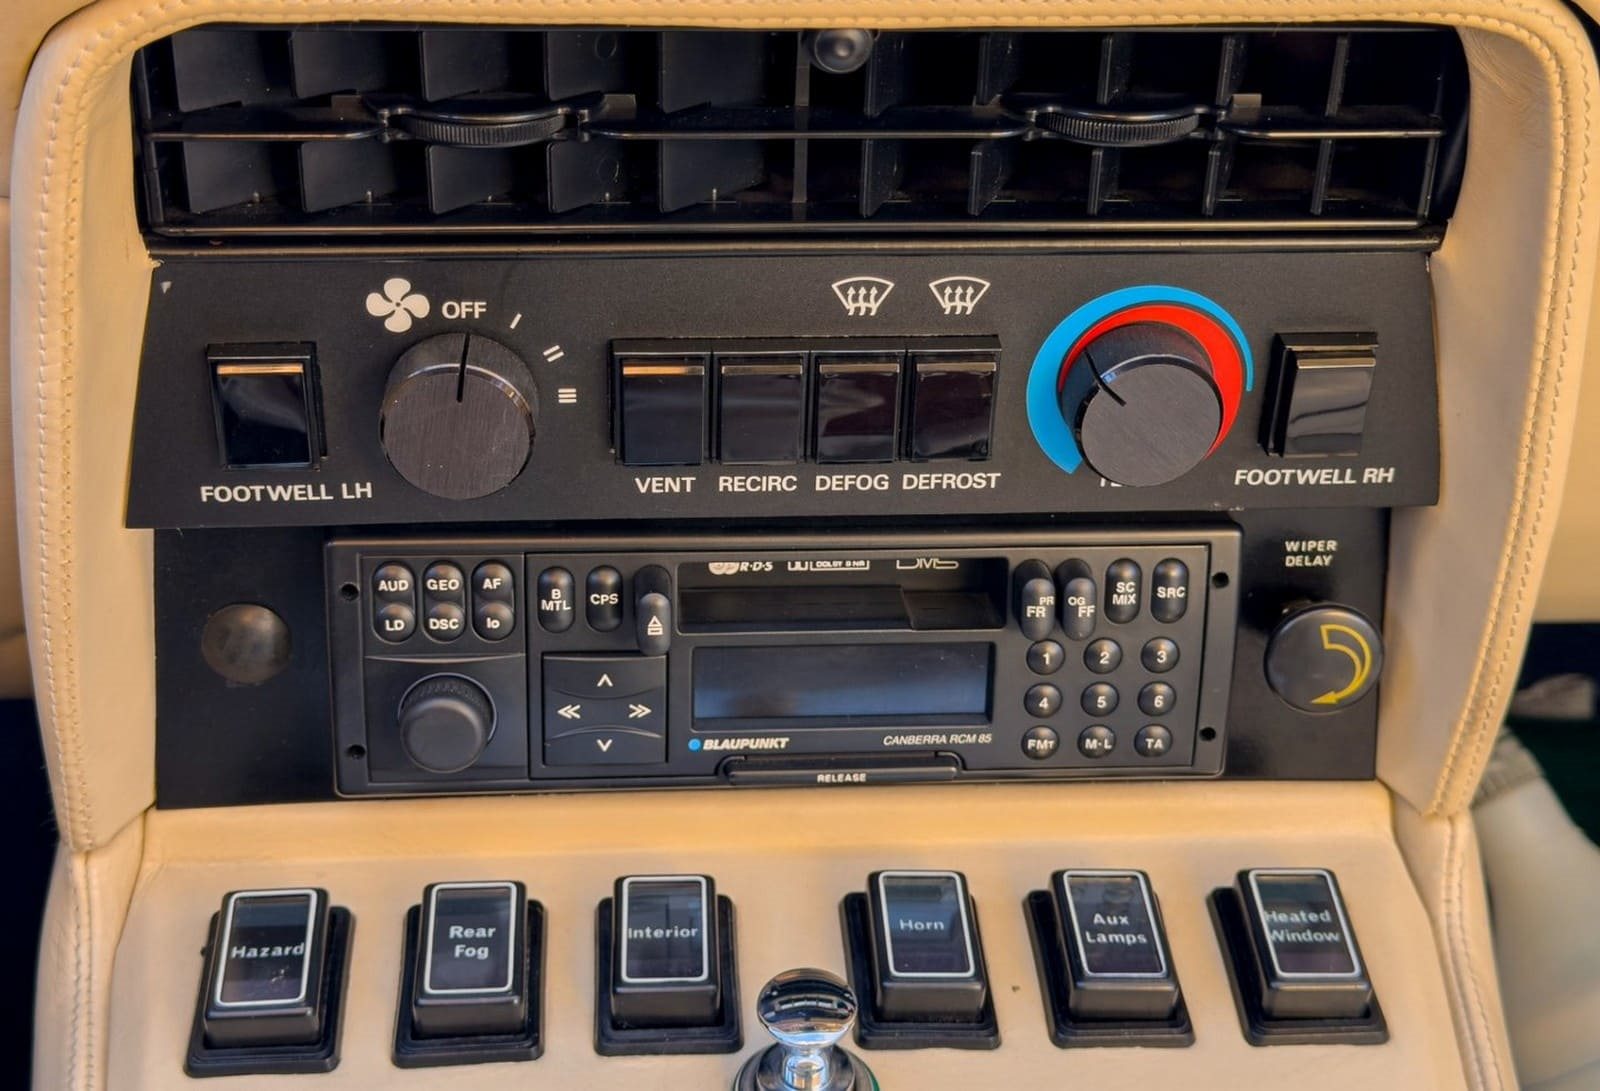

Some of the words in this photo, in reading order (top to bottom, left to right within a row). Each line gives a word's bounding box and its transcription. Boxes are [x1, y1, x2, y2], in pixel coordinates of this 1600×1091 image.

[442, 301, 486, 319] OFF
[816, 475, 889, 491] DEFOG
[902, 473, 1001, 490] DEFROST
[1234, 468, 1356, 485] FOOTWELL
[1363, 468, 1395, 483] RH
[635, 477, 696, 493] VENT
[719, 476, 797, 492] RECIRC
[200, 484, 333, 502] FOOTWELL
[342, 482, 372, 499] LH
[1285, 540, 1337, 552] WIPER
[1285, 555, 1333, 567] DELAY
[379, 579, 409, 592] AUD
[427, 578, 460, 591] GEO
[483, 578, 502, 589] AF
[1116, 581, 1136, 594] SC
[551, 589, 561, 600] B
[1157, 586, 1185, 598] SRC
[590, 593, 618, 605] CPS
[1039, 596, 1054, 606] PR
[1067, 596, 1086, 606] OG
[1112, 593, 1137, 606] MIX
[541, 600, 571, 612] MTL
[1026, 606, 1046, 618] FR
[1078, 605, 1096, 618] FF
[385, 619, 405, 631] LD
[429, 617, 459, 630] DSC
[1043, 652, 1051, 665] 1
[1100, 651, 1109, 664] 2
[1157, 651, 1167, 663] 3
[1039, 697, 1049, 709] 4
[1097, 696, 1107, 708] 5
[1154, 695, 1164, 708] 6
[703, 738, 789, 750] BLAUPUNKT
[883, 735, 947, 746] CANBERRA
[950, 734, 976, 744] RCM
[978, 734, 992, 743] 85
[1146, 738, 1163, 749] TA
[817, 773, 866, 782] RELEASE
[1093, 913, 1129, 926] Aux
[1265, 909, 1331, 924] Heated
[899, 919, 944, 930] Horn
[449, 926, 496, 939] Rear
[627, 925, 698, 940] Interior
[1085, 931, 1147, 945] Lamps
[1268, 928, 1340, 943] Window
[229, 942, 306, 960] Hazard
[455, 944, 489, 960] Fog
